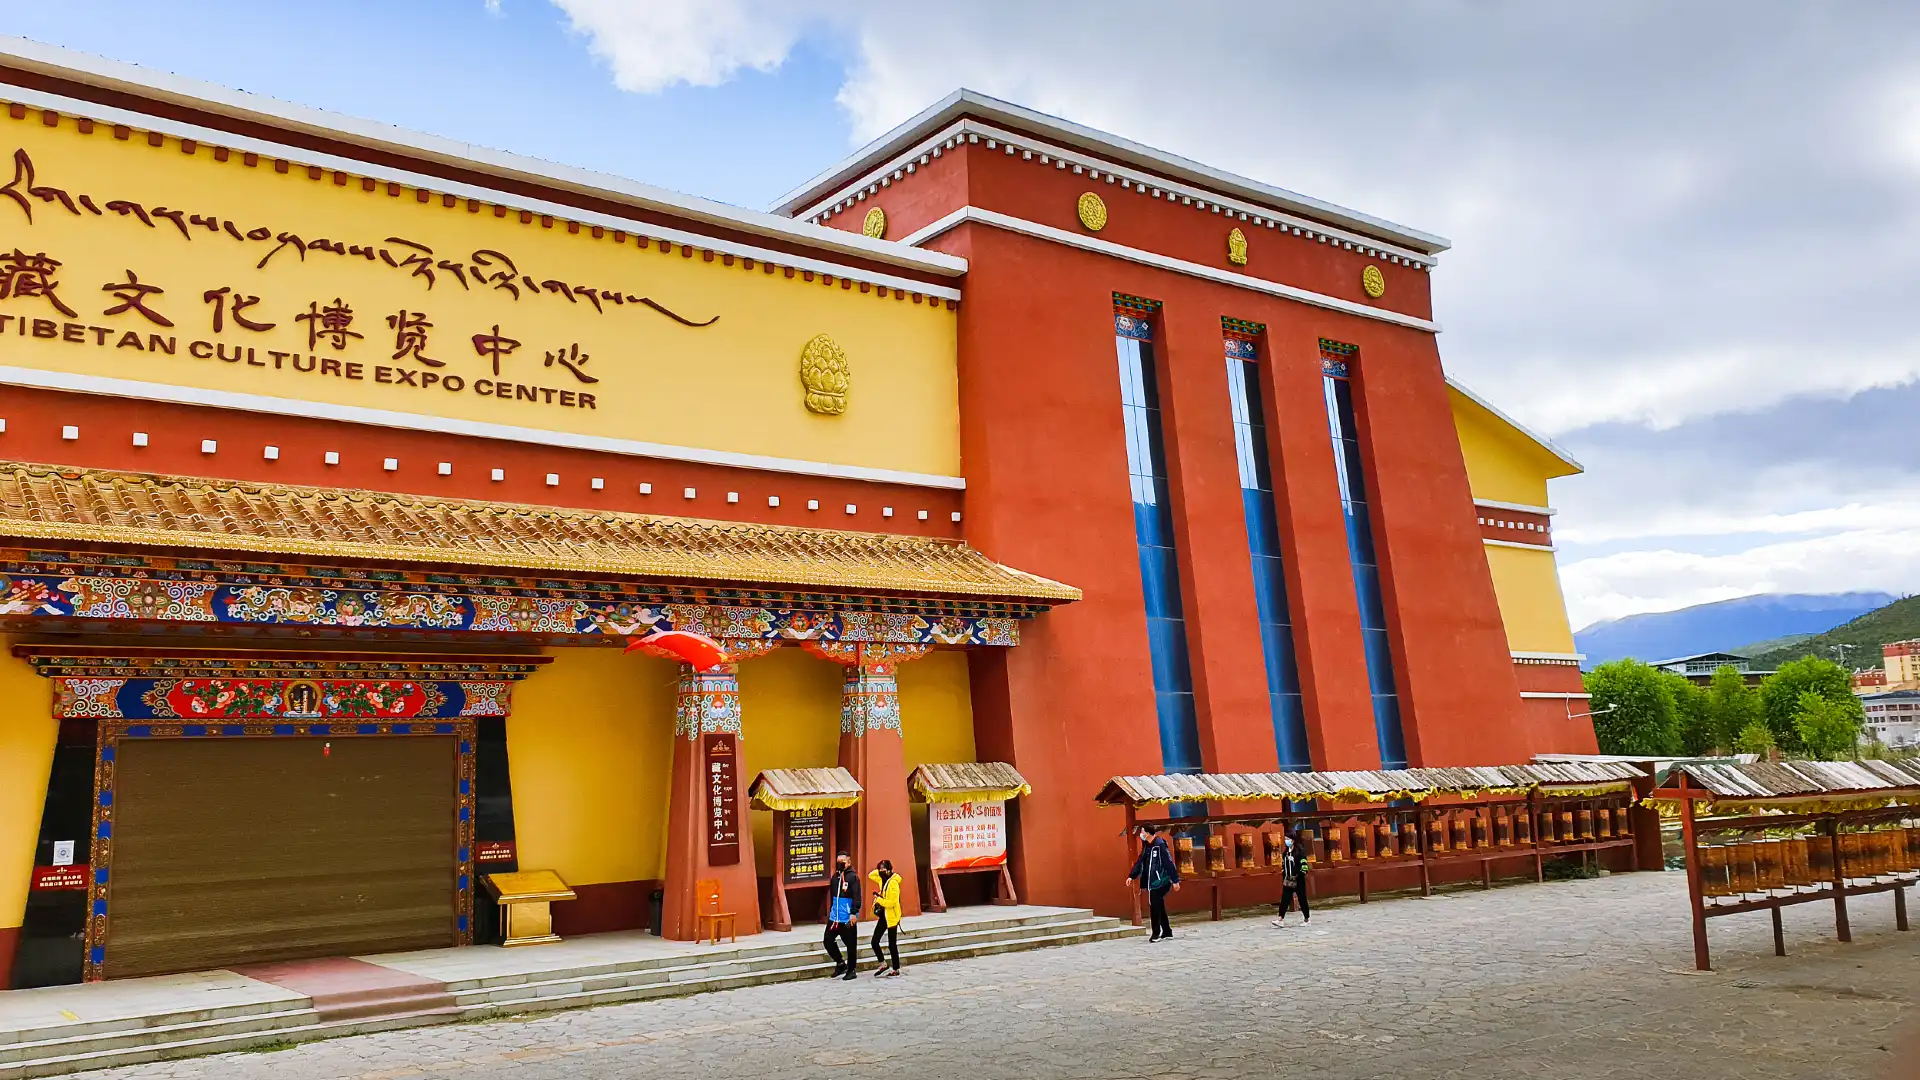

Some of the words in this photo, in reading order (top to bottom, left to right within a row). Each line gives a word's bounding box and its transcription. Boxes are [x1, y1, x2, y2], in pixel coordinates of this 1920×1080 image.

[0, 315, 176, 355] TIBETAN
[188, 341, 364, 380] CULTURE
[375, 366, 465, 392] EXPO
[474, 380, 597, 409] CENTER
